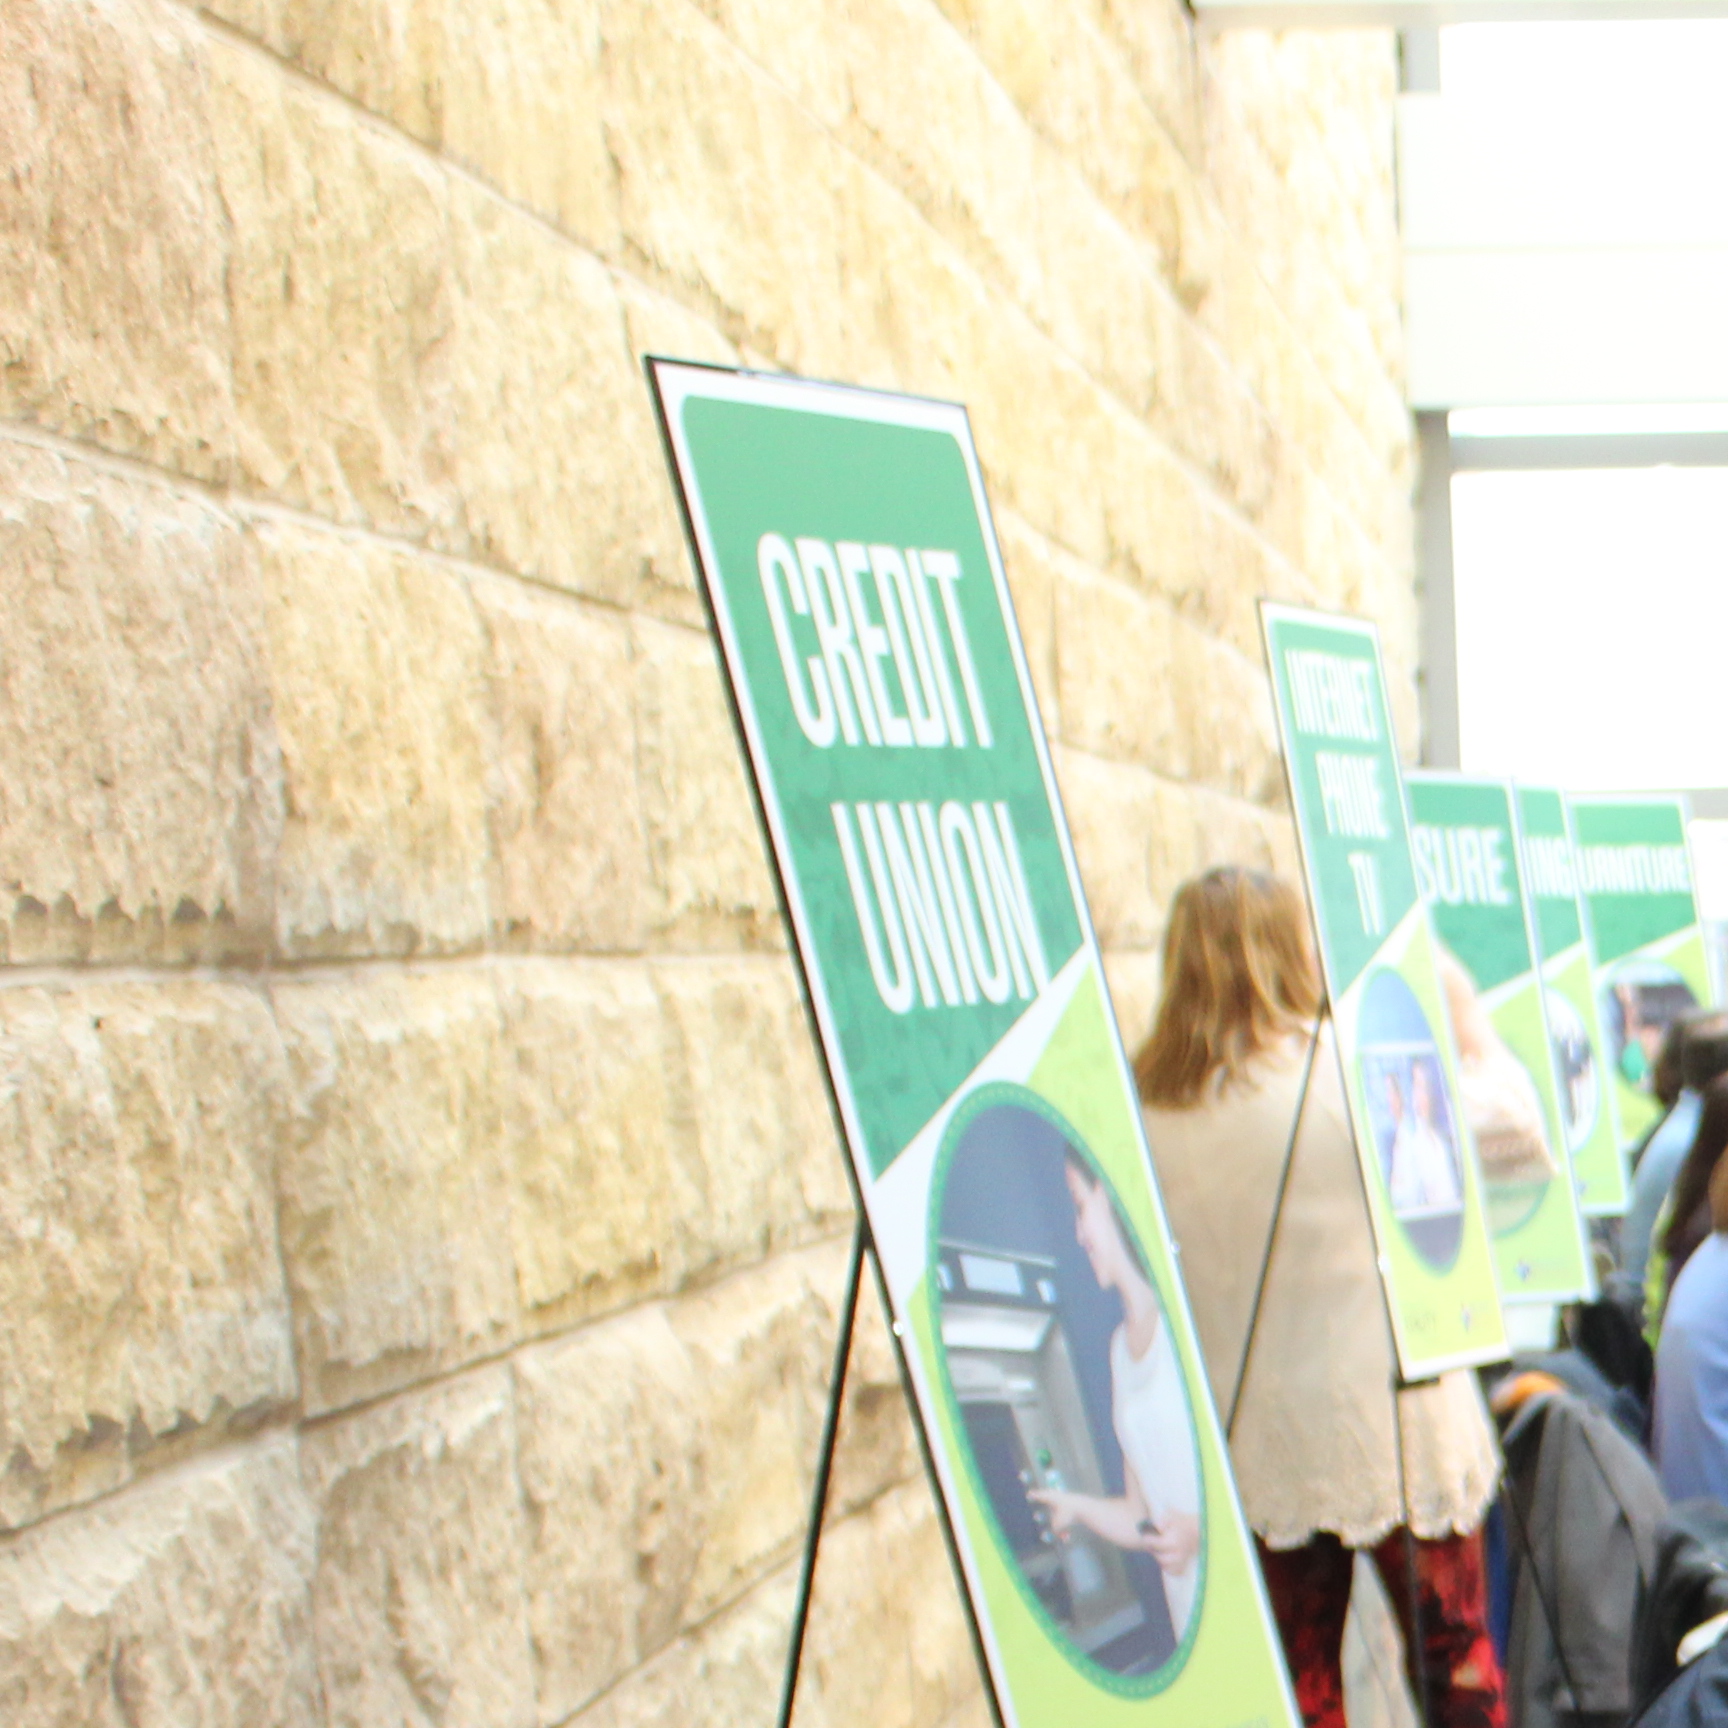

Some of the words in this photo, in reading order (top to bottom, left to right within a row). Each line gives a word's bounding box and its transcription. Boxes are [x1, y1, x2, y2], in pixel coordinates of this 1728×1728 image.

[757, 532, 994, 749] CREDIT
[1284, 648, 1382, 740] INTERNET
[1315, 750, 1391, 838] PHONE
[830, 801, 1049, 1015] UNION
[1347, 852, 1384, 938] TV
